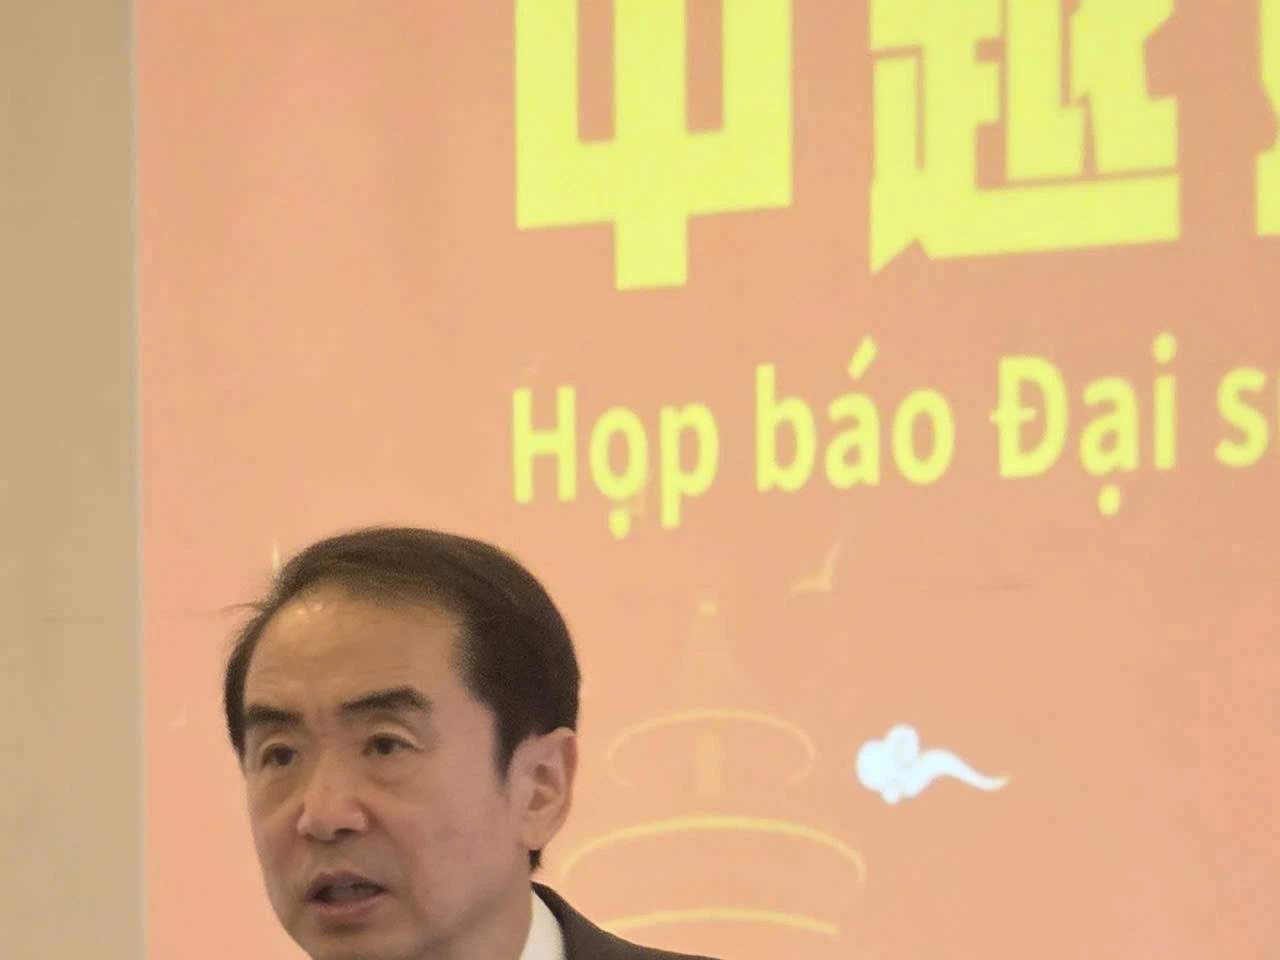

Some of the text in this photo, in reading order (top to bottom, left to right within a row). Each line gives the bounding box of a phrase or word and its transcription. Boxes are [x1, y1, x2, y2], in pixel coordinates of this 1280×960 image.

[516, 0, 1280, 290] 中越
[513, 332, 1280, 539] Họp báo Đại s
